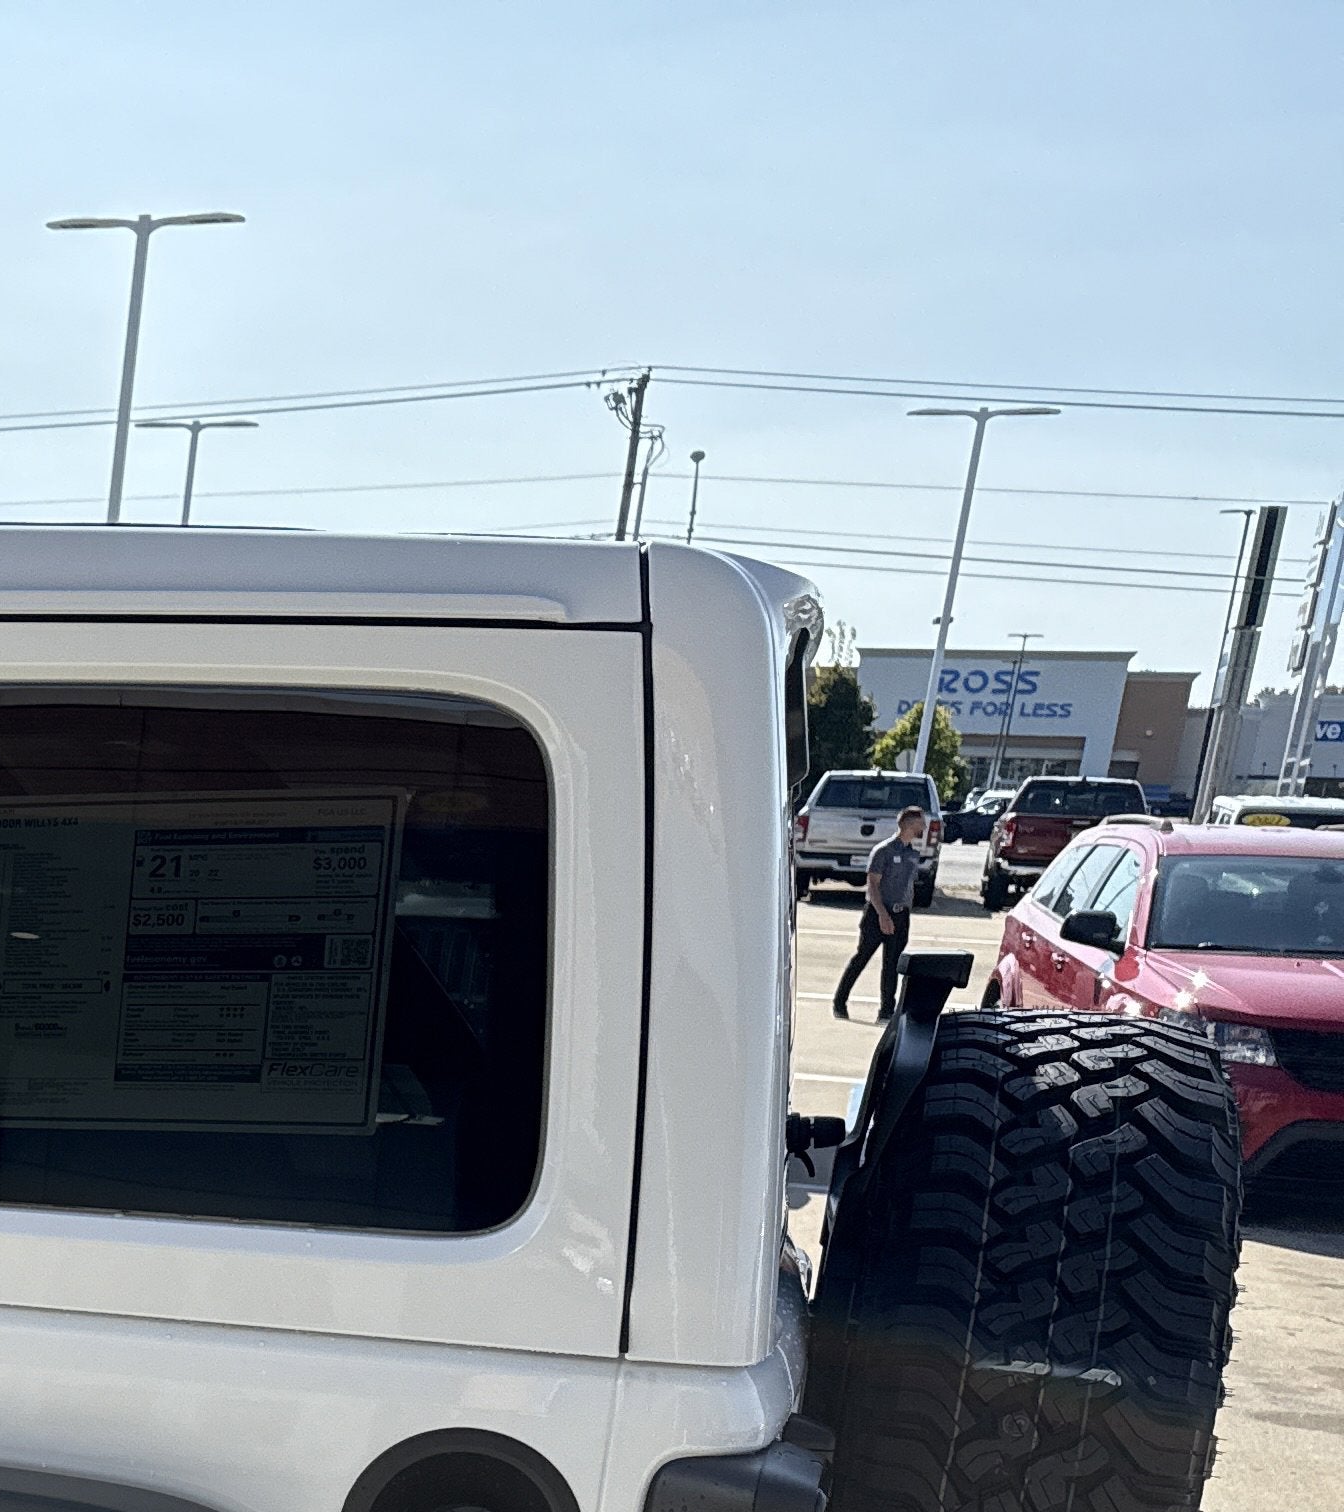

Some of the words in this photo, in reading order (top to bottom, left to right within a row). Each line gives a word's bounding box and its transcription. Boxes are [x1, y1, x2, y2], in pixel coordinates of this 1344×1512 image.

[938, 669, 1040, 694] ROSS
[969, 701, 1010, 717] FOR
[1019, 702, 1073, 718] LESS
[24, 817, 59, 828] WILLYS
[330, 844, 365, 856] spend
[148, 854, 182, 878] 21
[312, 856, 367, 872] $3,000
[166, 902, 189, 911] cost
[131, 912, 185, 928] $2,500
[267, 1061, 359, 1078] FlexCare
